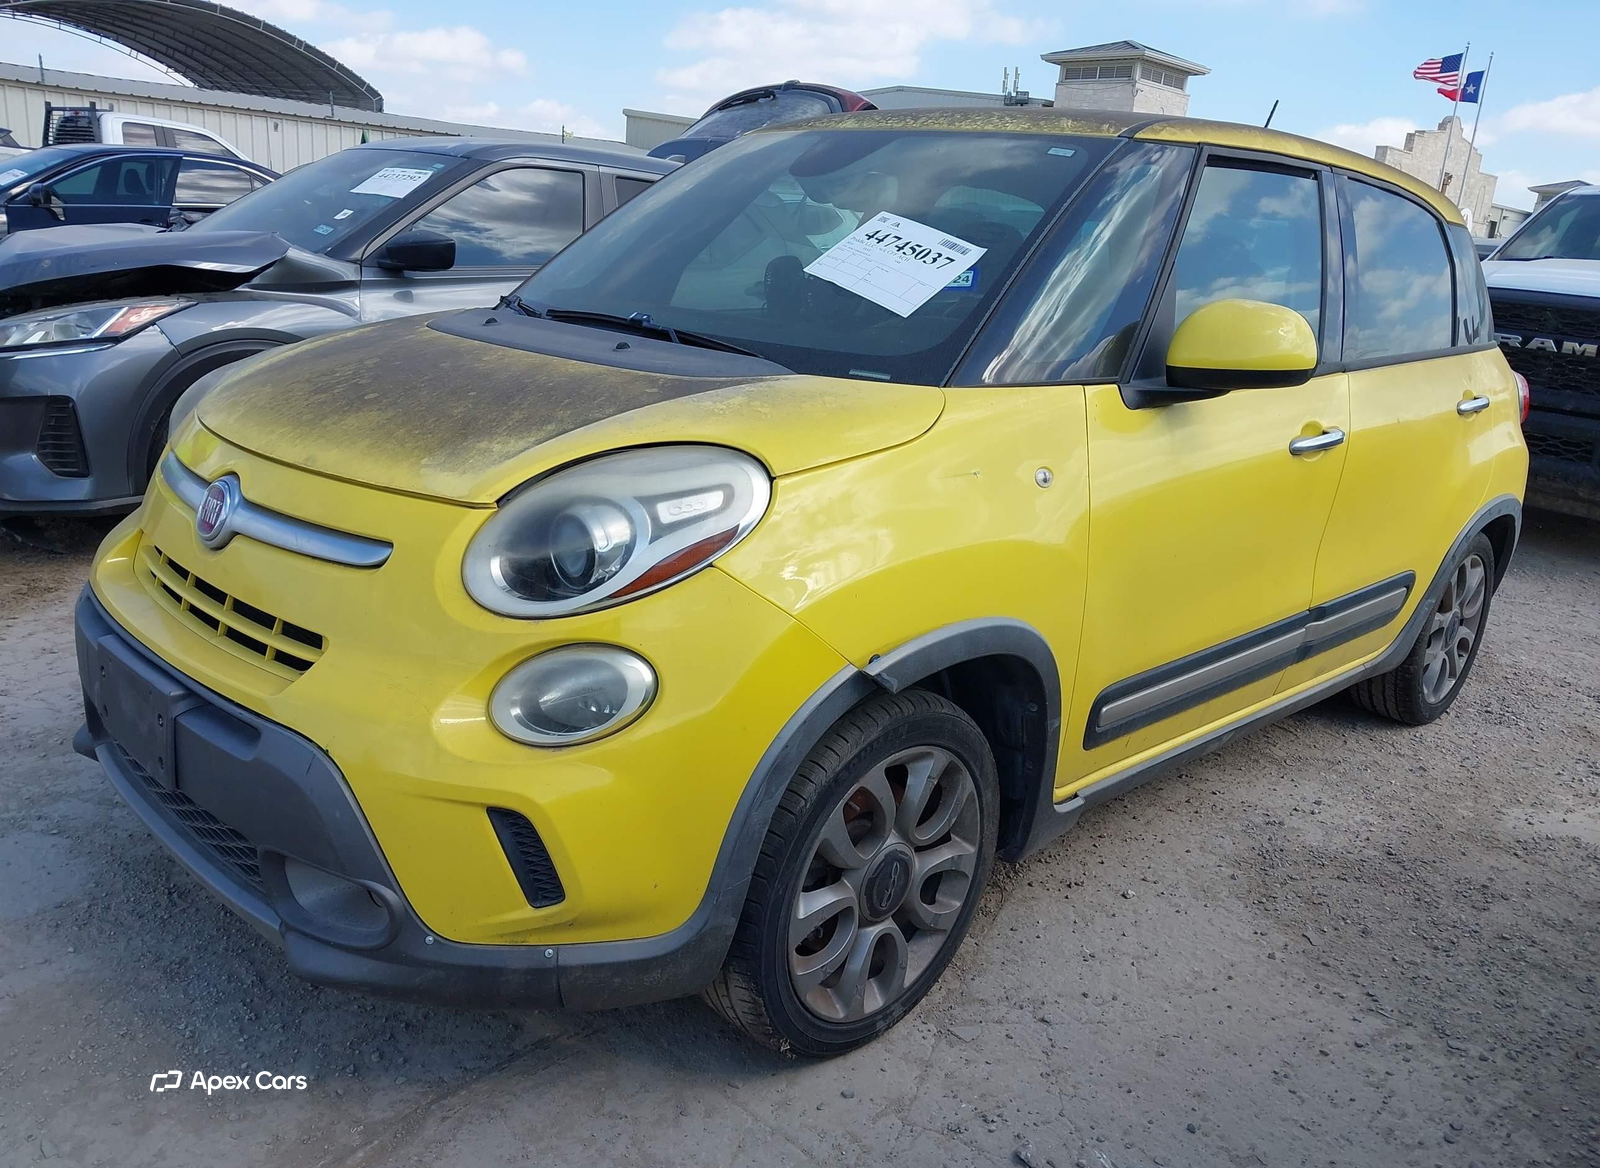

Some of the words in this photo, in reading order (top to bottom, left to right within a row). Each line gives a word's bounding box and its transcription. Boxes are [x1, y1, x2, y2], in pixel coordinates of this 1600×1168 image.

[864, 229, 956, 270] 44745037
[1494, 332, 1598, 357] RAM
[202, 496, 223, 525] FIAT
